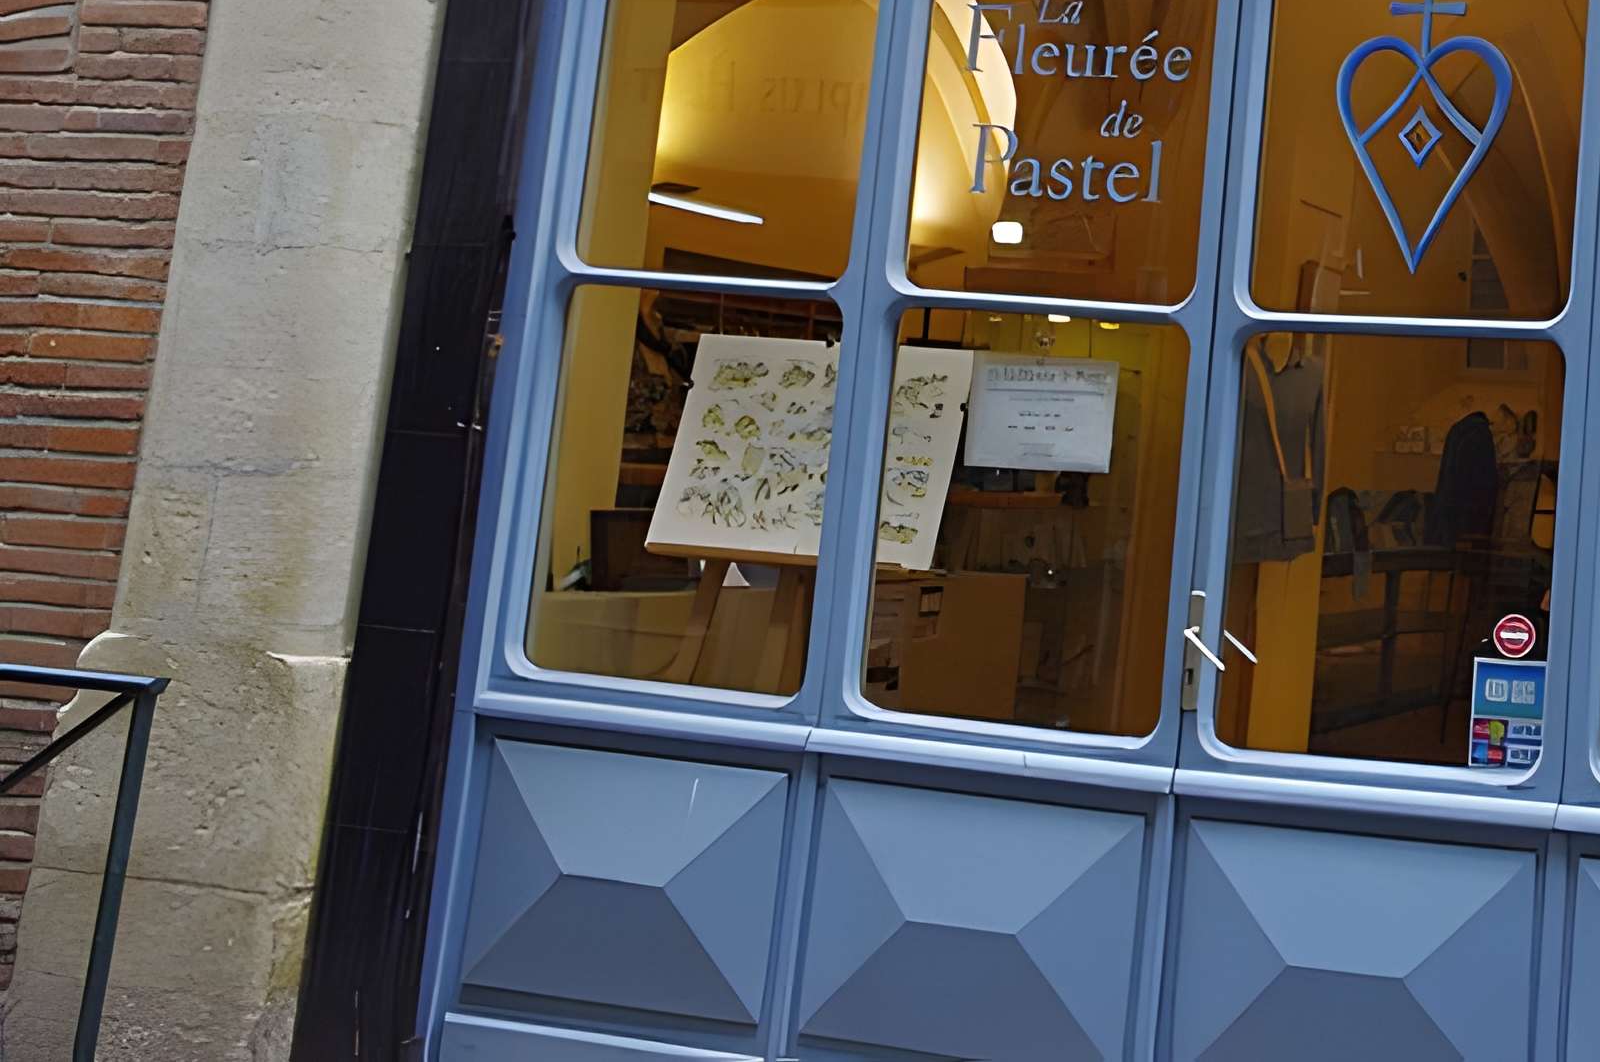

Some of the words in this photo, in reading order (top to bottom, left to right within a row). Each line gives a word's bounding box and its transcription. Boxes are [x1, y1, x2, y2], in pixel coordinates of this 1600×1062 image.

[966, 2, 1193, 83] Fleurée
[1099, 98, 1144, 139] de
[968, 123, 1163, 204] Pastel
